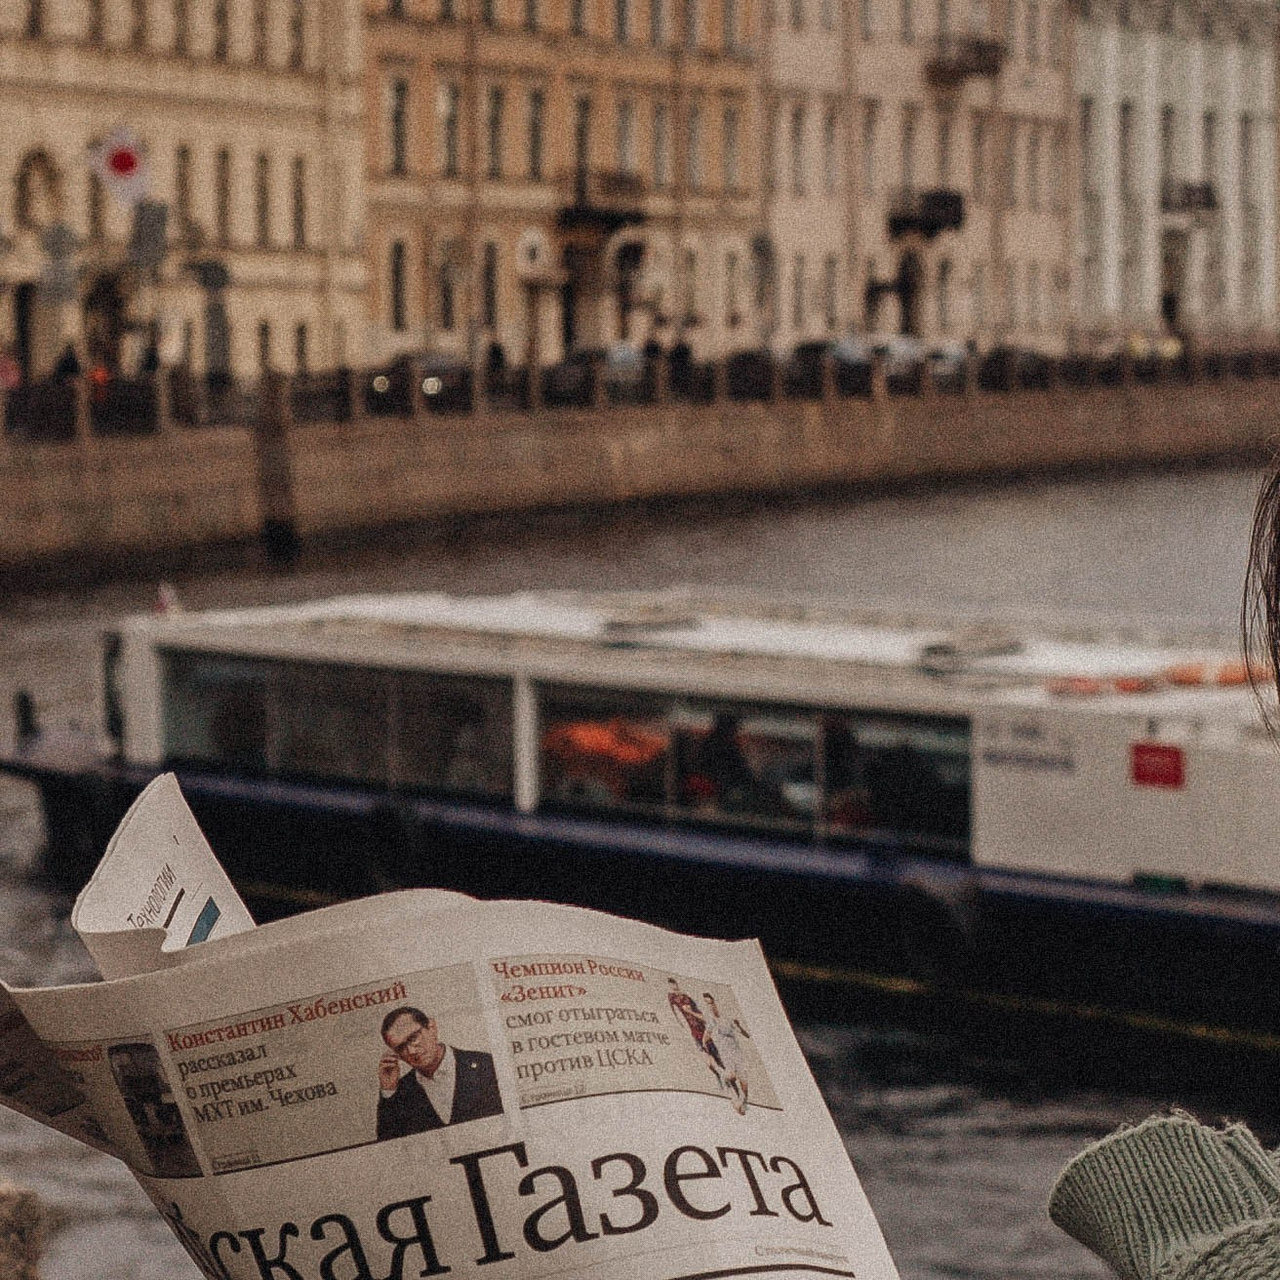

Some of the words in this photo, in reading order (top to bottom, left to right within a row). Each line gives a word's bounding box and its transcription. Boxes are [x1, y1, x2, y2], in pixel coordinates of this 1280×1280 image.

[492, 961, 586, 980] Чемпион
[587, 959, 646, 983] России
[500, 984, 587, 1003] «Зенит»
[167, 1013, 286, 1053] Константин
[287, 981, 408, 1025] Хабенский
[505, 1008, 553, 1029] смог
[558, 1006, 660, 1025] отыграться
[511, 1040, 524, 1055] в
[527, 1029, 619, 1053] гостевом
[622, 1029, 672, 1046] матче
[176, 1044, 269, 1082] рассказал
[516, 1054, 595, 1082] против
[598, 1048, 654, 1070] ЦСКА
[186, 1087, 197, 1101] о
[199, 1063, 298, 1101] премьерах
[190, 1099, 234, 1124] МХТ
[238, 1098, 269, 1117] им.
[268, 1080, 339, 1108] Чехова
[449, 1141, 834, 1269] Газета
